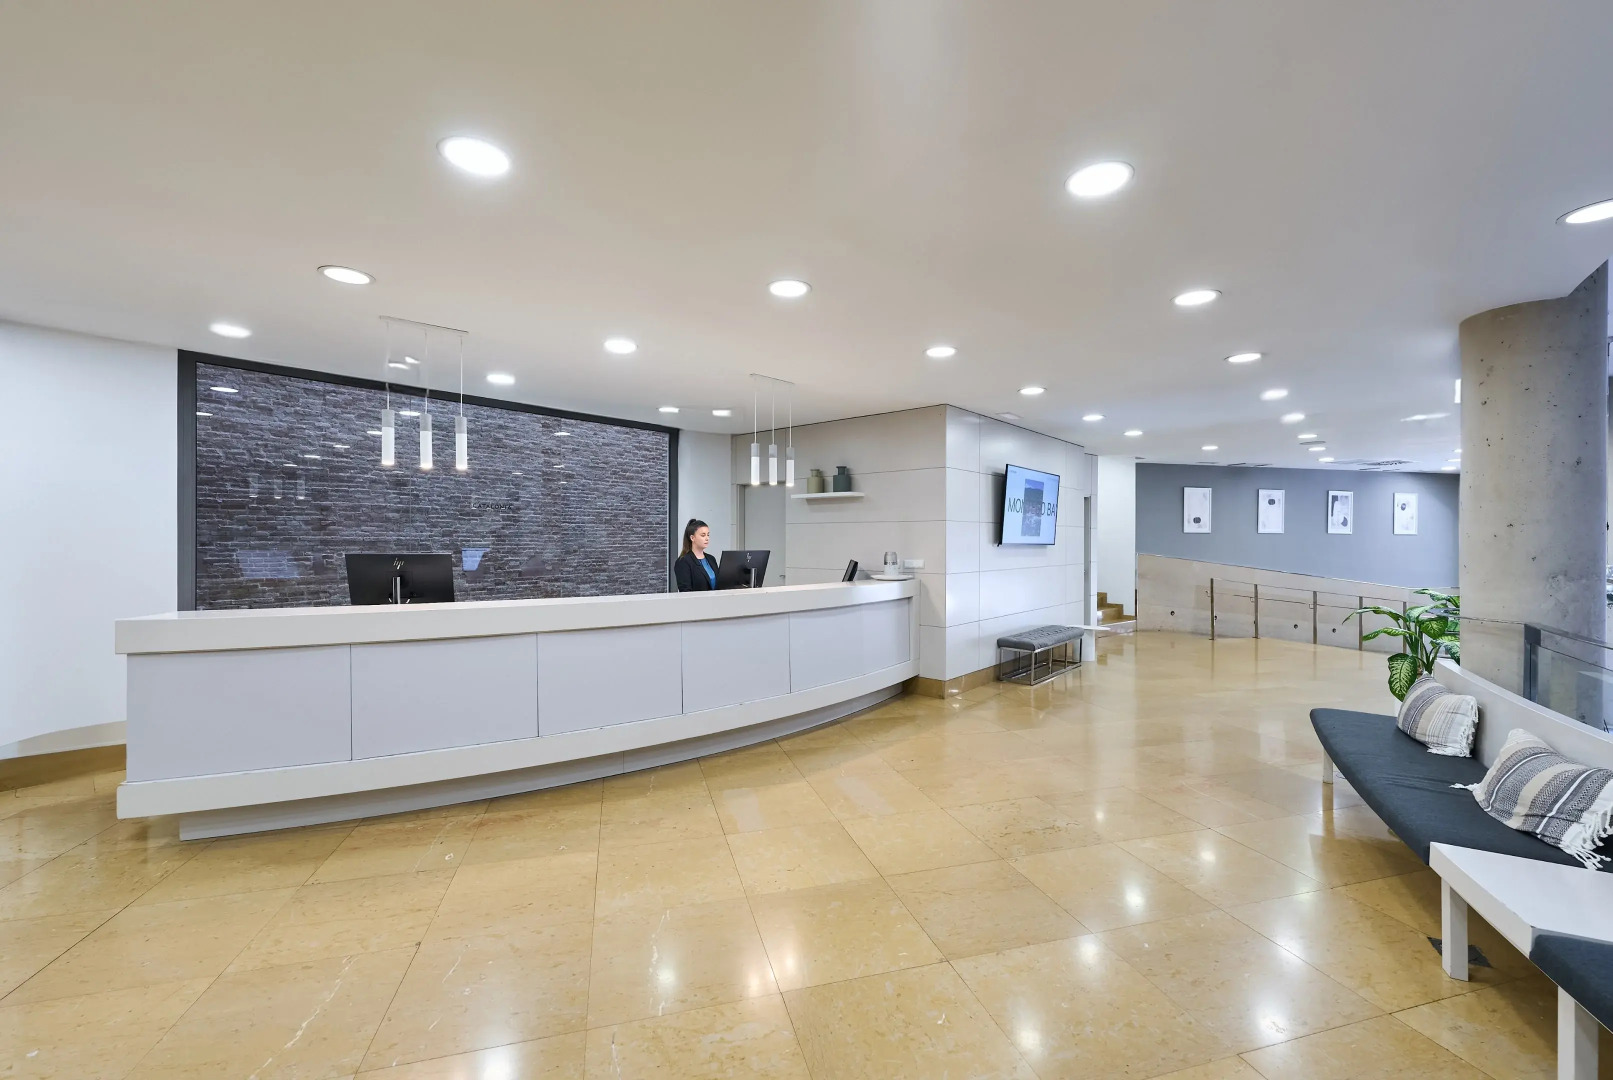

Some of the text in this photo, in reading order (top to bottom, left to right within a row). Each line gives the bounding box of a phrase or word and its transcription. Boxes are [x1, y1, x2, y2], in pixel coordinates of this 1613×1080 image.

[472, 502, 512, 510] CATALONIA
[1007, 497, 1057, 517] MONO BA
